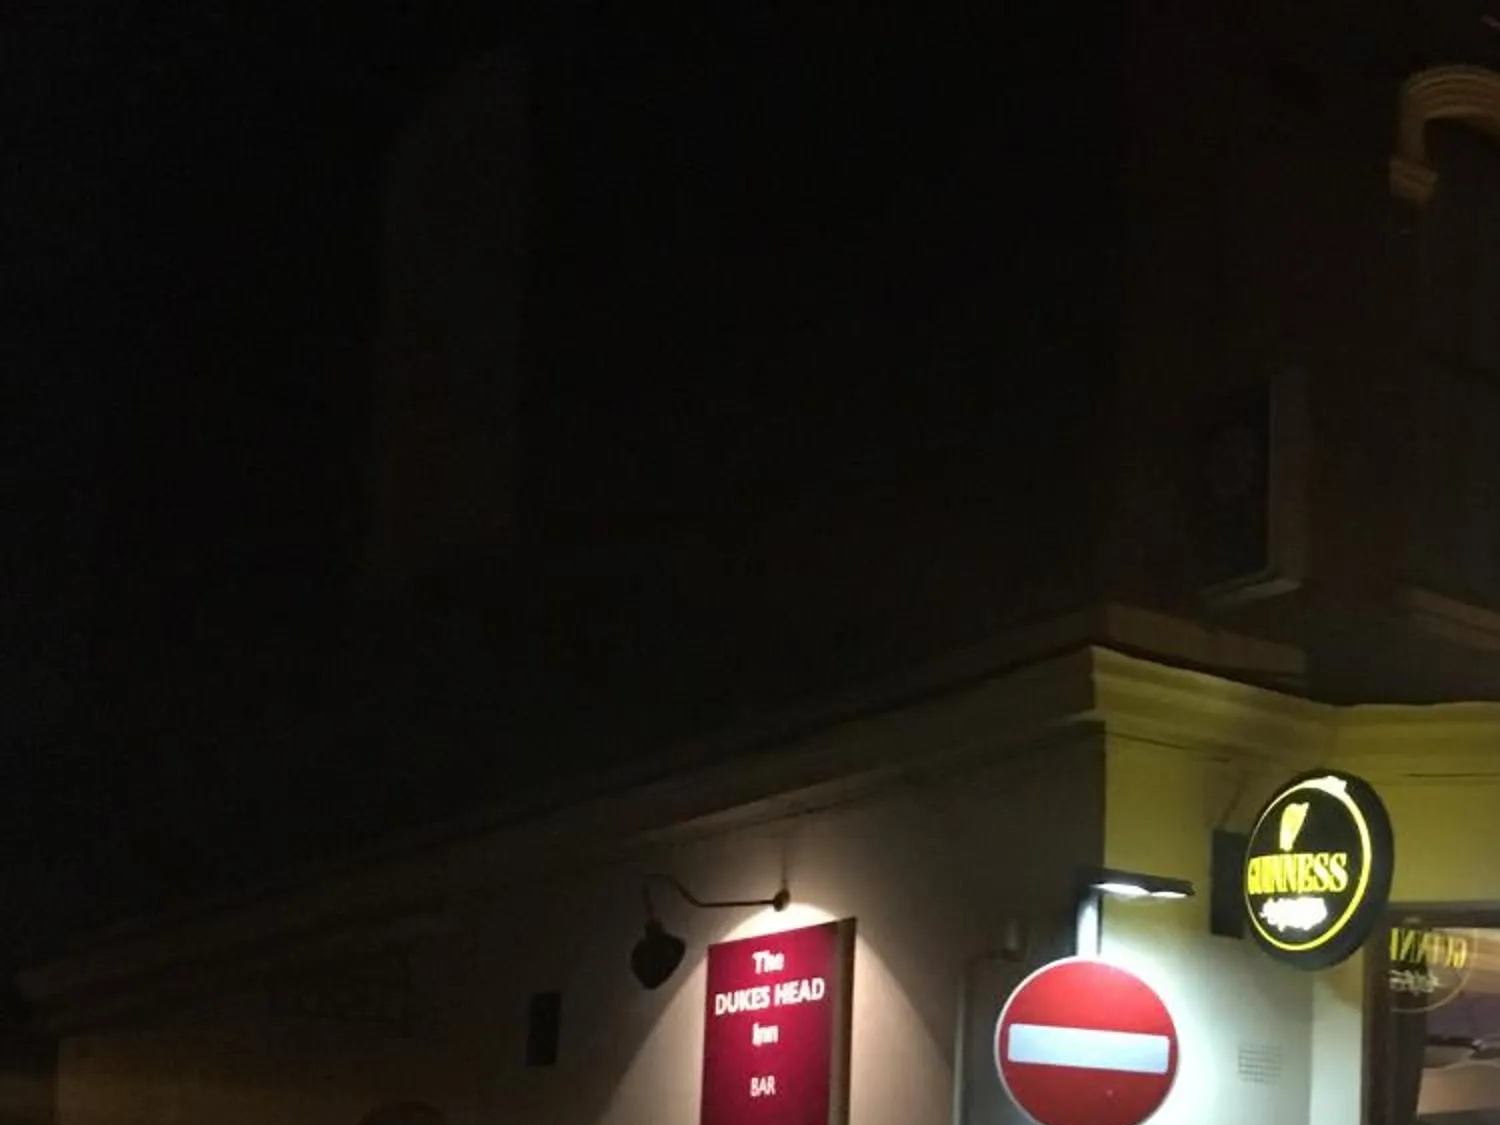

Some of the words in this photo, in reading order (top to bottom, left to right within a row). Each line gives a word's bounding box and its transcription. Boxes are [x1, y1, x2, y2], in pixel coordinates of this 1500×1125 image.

[1247, 852, 1349, 896] GUINNESS
[752, 950, 785, 974] The
[714, 985, 771, 1016] DUKES
[774, 977, 826, 1007] HEAD
[752, 1022, 779, 1047] Inn
[751, 1075, 776, 1097] BAR
